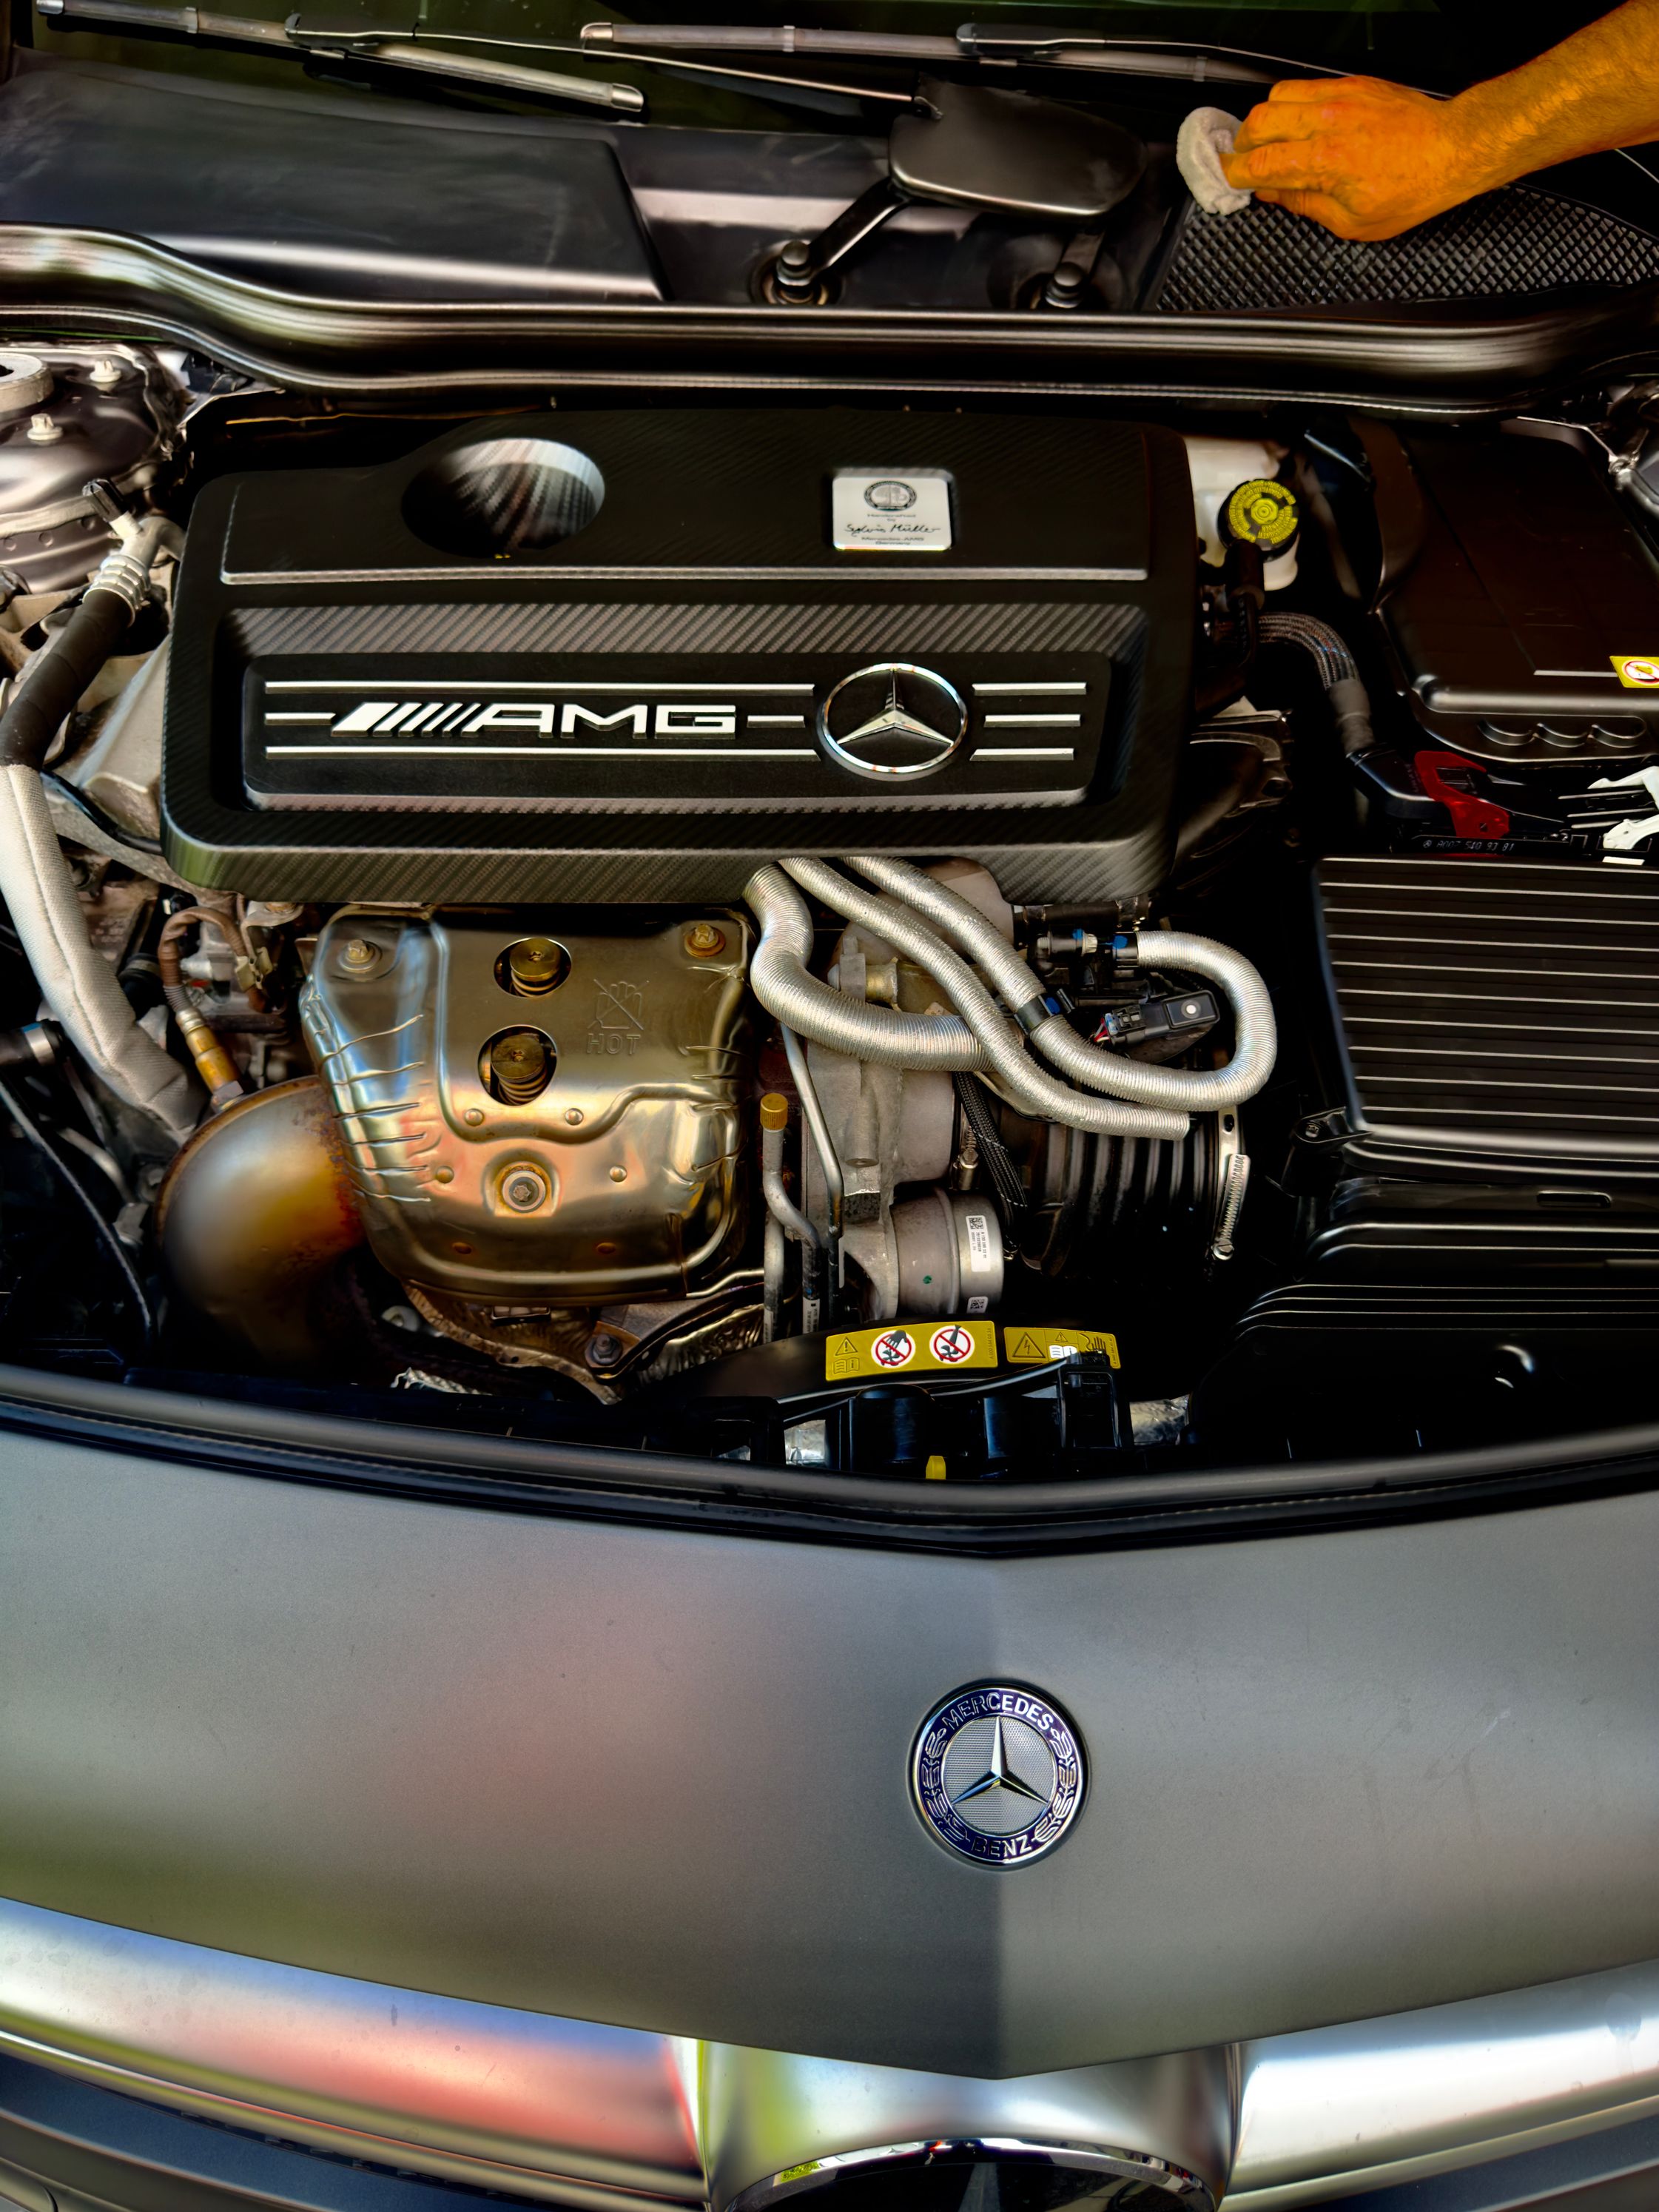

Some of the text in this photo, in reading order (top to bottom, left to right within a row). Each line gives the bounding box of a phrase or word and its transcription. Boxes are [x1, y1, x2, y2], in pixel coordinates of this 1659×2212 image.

[461, 702, 736, 738] AMG
[587, 1033, 641, 1055] HOT
[942, 1692, 1054, 1730] MERCEDES
[971, 1835, 1032, 1857] BENZ
